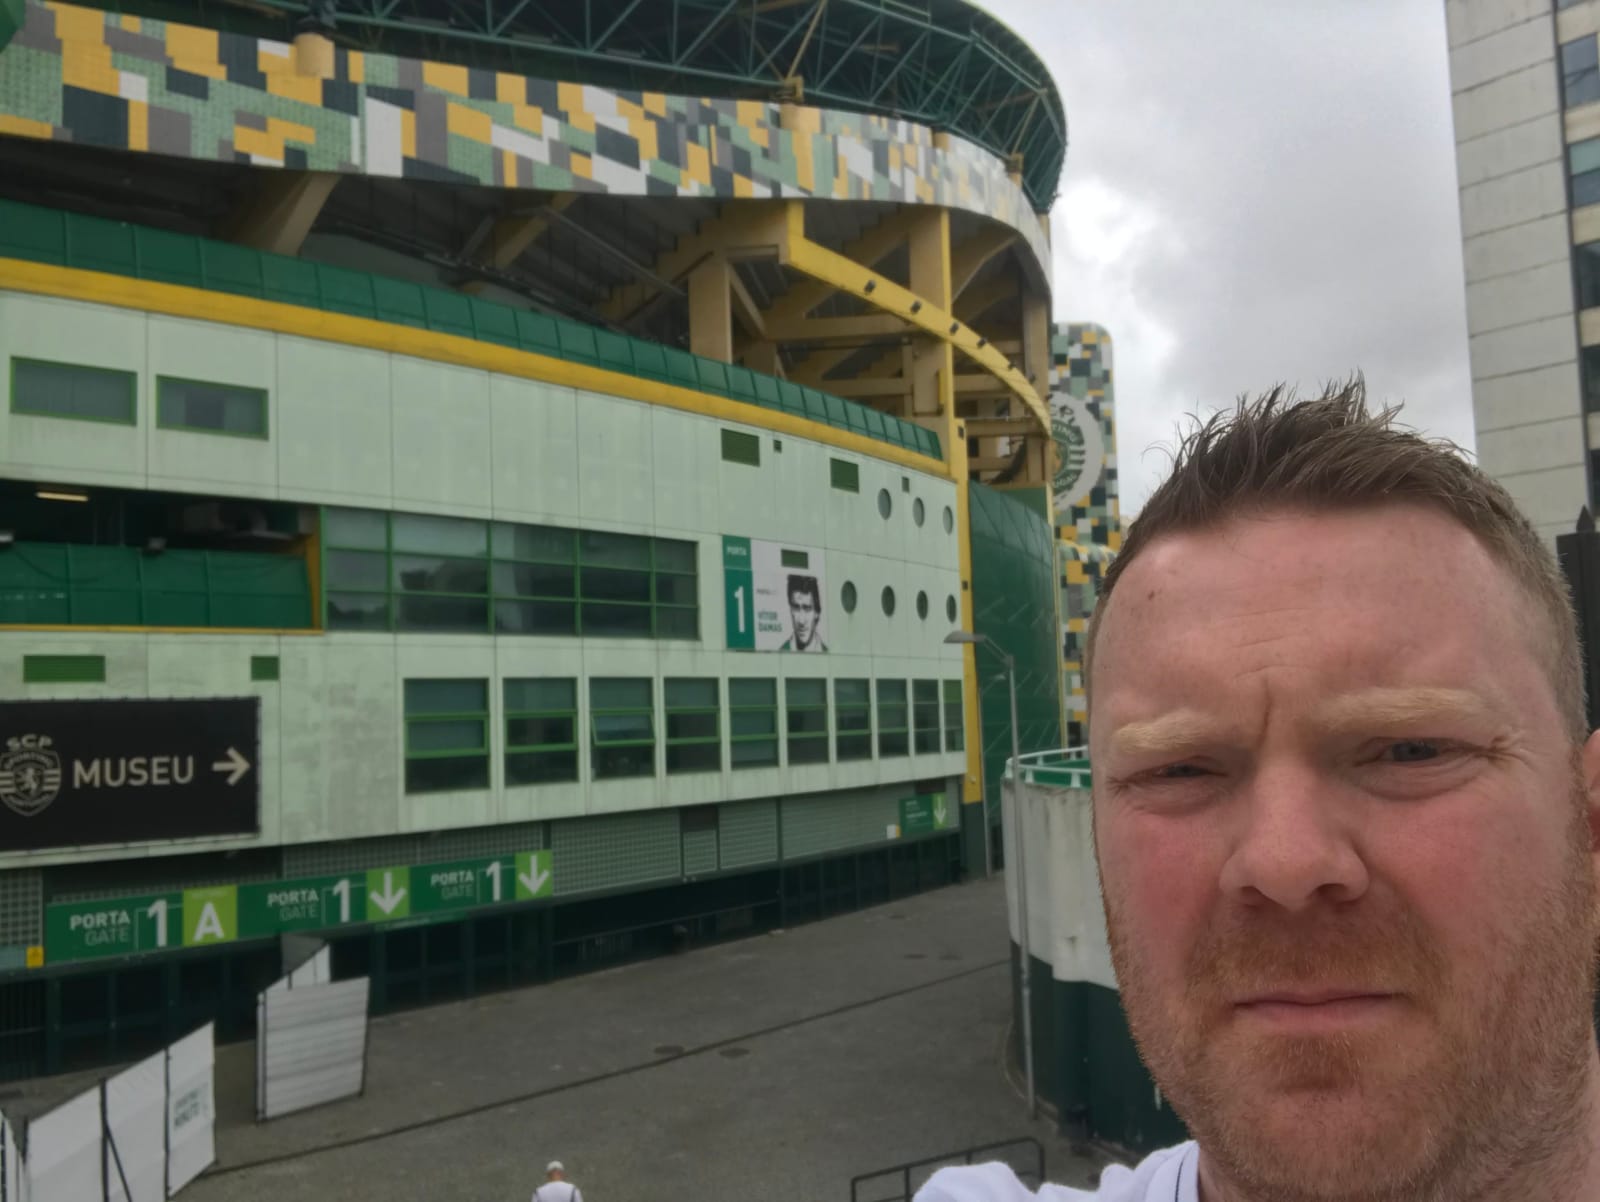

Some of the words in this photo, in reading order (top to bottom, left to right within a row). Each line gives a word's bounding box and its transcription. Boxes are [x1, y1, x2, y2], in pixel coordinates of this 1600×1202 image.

[727, 546, 746, 556] PORTA
[734, 586, 746, 633] 1
[6, 734, 52, 751] SCP
[73, 756, 194, 789] MUSEU
[431, 871, 475, 887] PORTA
[486, 861, 502, 902] 1
[441, 884, 473, 900] GATE
[267, 889, 319, 907] PORTA
[332, 878, 351, 923] 1
[280, 905, 317, 921] GATE
[70, 911, 131, 930] PORTA
[146, 898, 168, 947] 1
[193, 901, 225, 942] A
[84, 928, 130, 945] GATE
